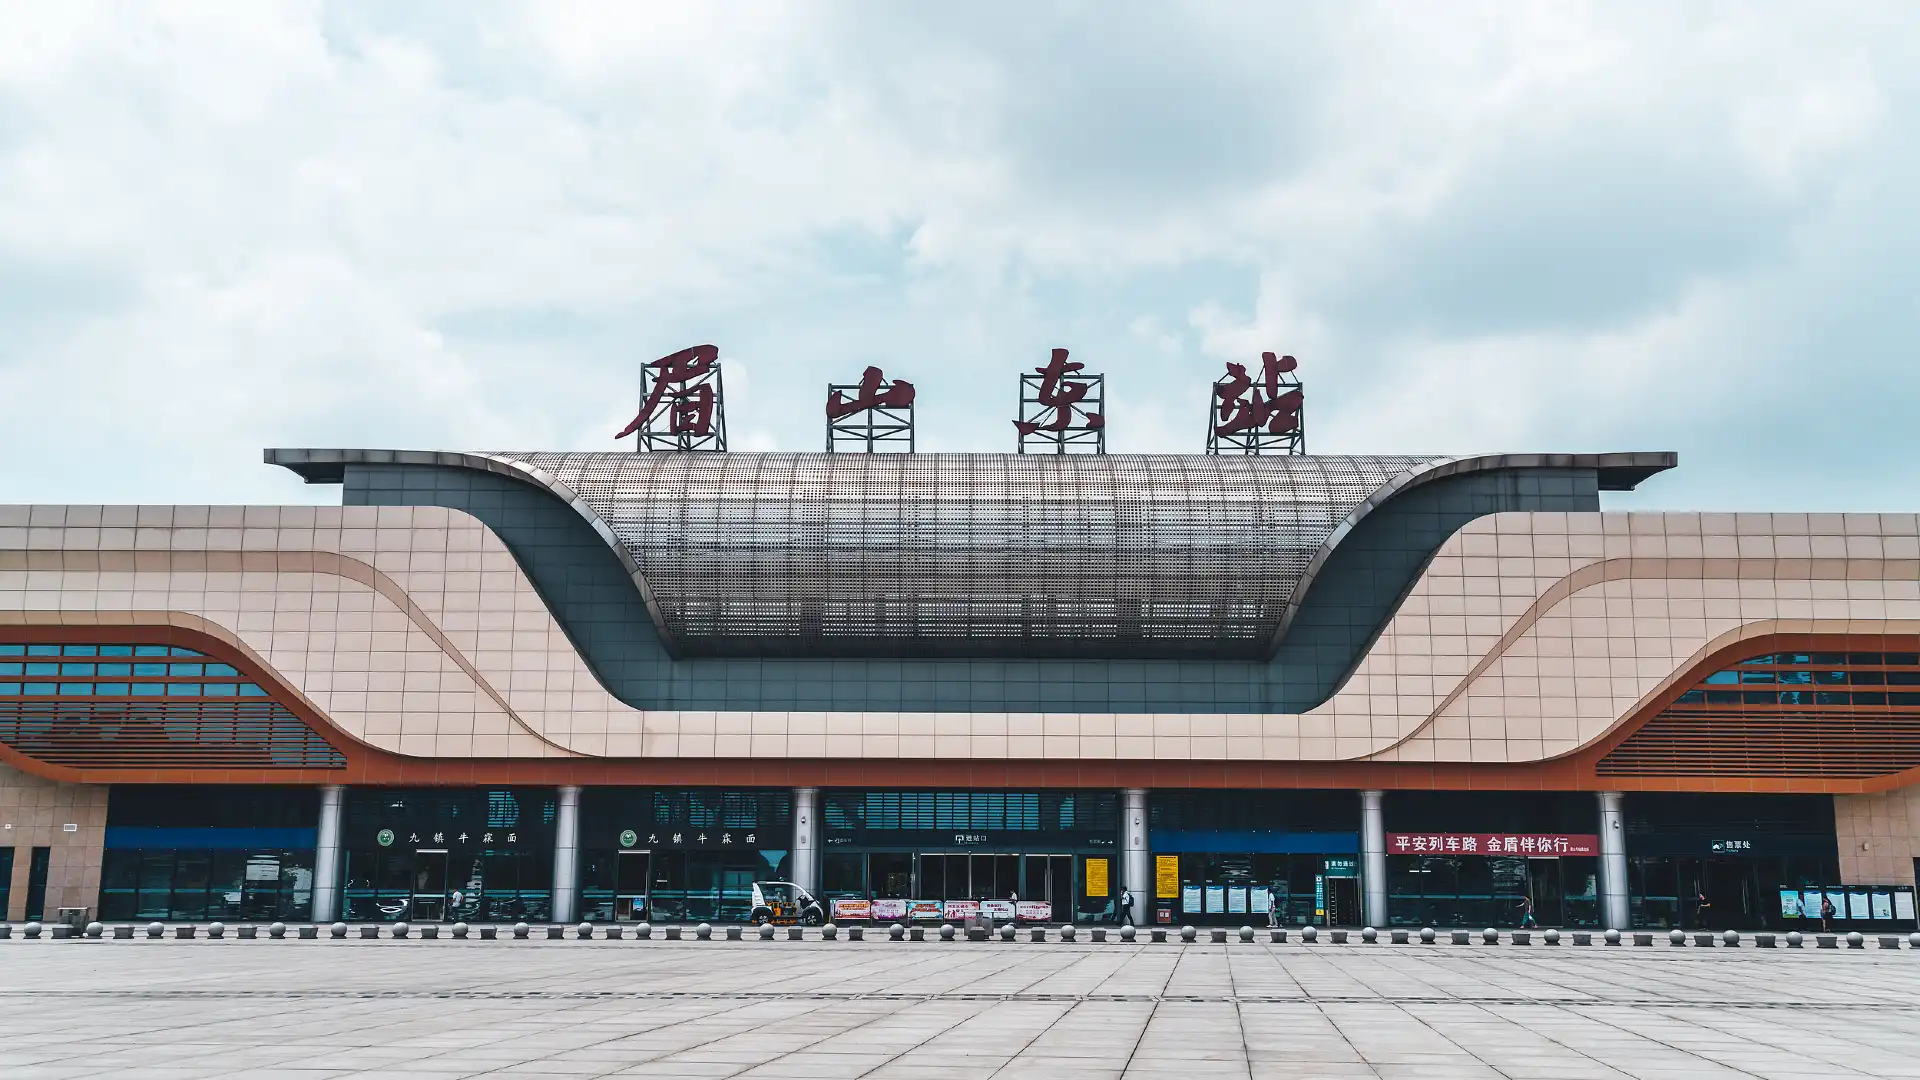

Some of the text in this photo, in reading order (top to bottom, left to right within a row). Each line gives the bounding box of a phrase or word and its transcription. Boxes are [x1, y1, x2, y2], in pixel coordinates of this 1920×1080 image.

[1395, 836, 1478, 852] 平安列车路
[1487, 837, 1569, 853] 金盾伴你行
[1725, 840, 1751, 849] 售票处
